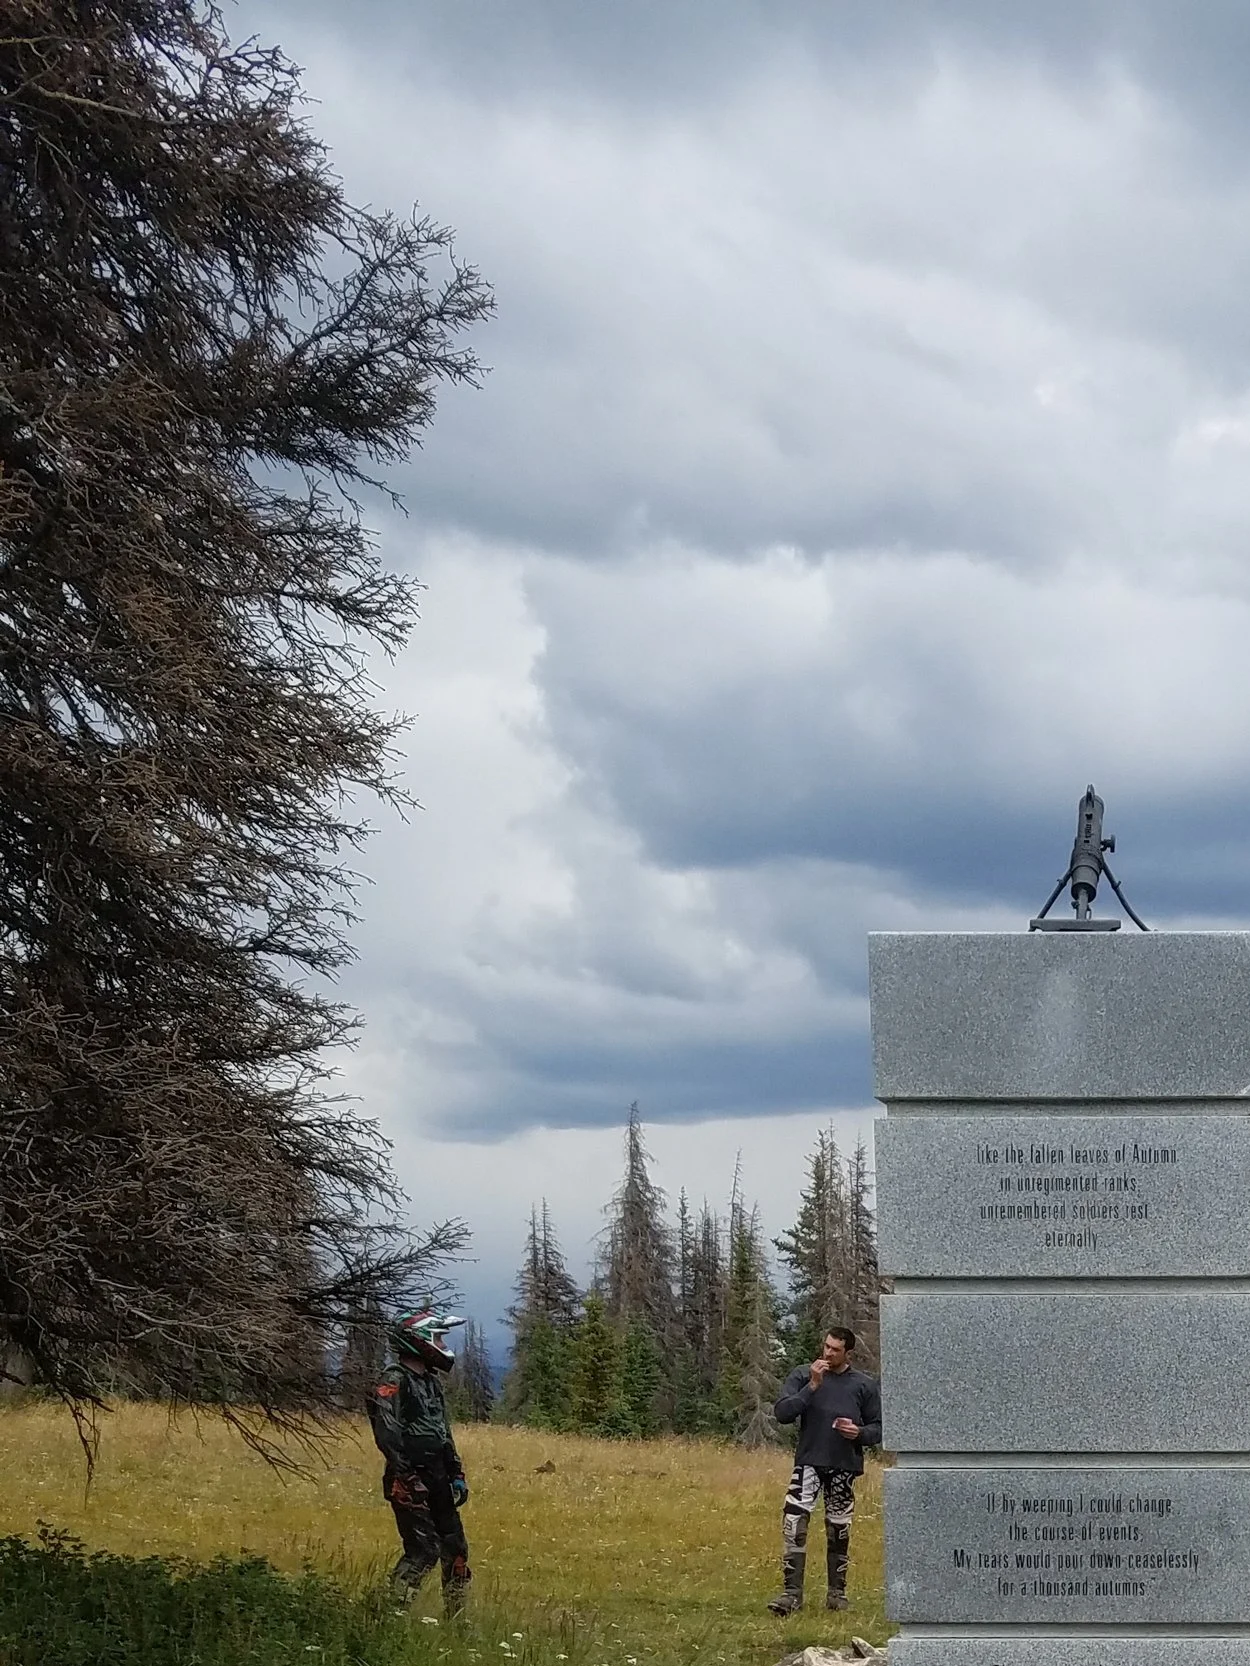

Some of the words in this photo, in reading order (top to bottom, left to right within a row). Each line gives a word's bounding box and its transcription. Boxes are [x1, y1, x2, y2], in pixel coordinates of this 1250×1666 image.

[1005, 1143, 1024, 1164] the
[1030, 1144, 1064, 1164] fallen
[1070, 1144, 1109, 1164] leaves
[1115, 1144, 1125, 1164] of
[1017, 1172, 1098, 1196] unregimented
[980, 1200, 1066, 1220] unremembered
[1072, 1200, 1119, 1220] soldiers
[1002, 1493, 1016, 1517] by
[1022, 1495, 1073, 1518] weeping
[1090, 1493, 1122, 1513] could
[1129, 1493, 1172, 1517] change
[1009, 1521, 1028, 1541] the
[1034, 1525, 1074, 1541] course
[1081, 1521, 1092, 1541] of
[953, 1549, 972, 1570] My
[979, 1552, 1009, 1569] tears
[1015, 1549, 1051, 1569] would
[1058, 1553, 1083, 1572] pour
[1090, 1549, 1121, 1569] down
[1128, 1548, 1199, 1573] ceaselessly
[998, 1577, 1015, 1596] for
[1034, 1576, 1088, 1596] thousand
